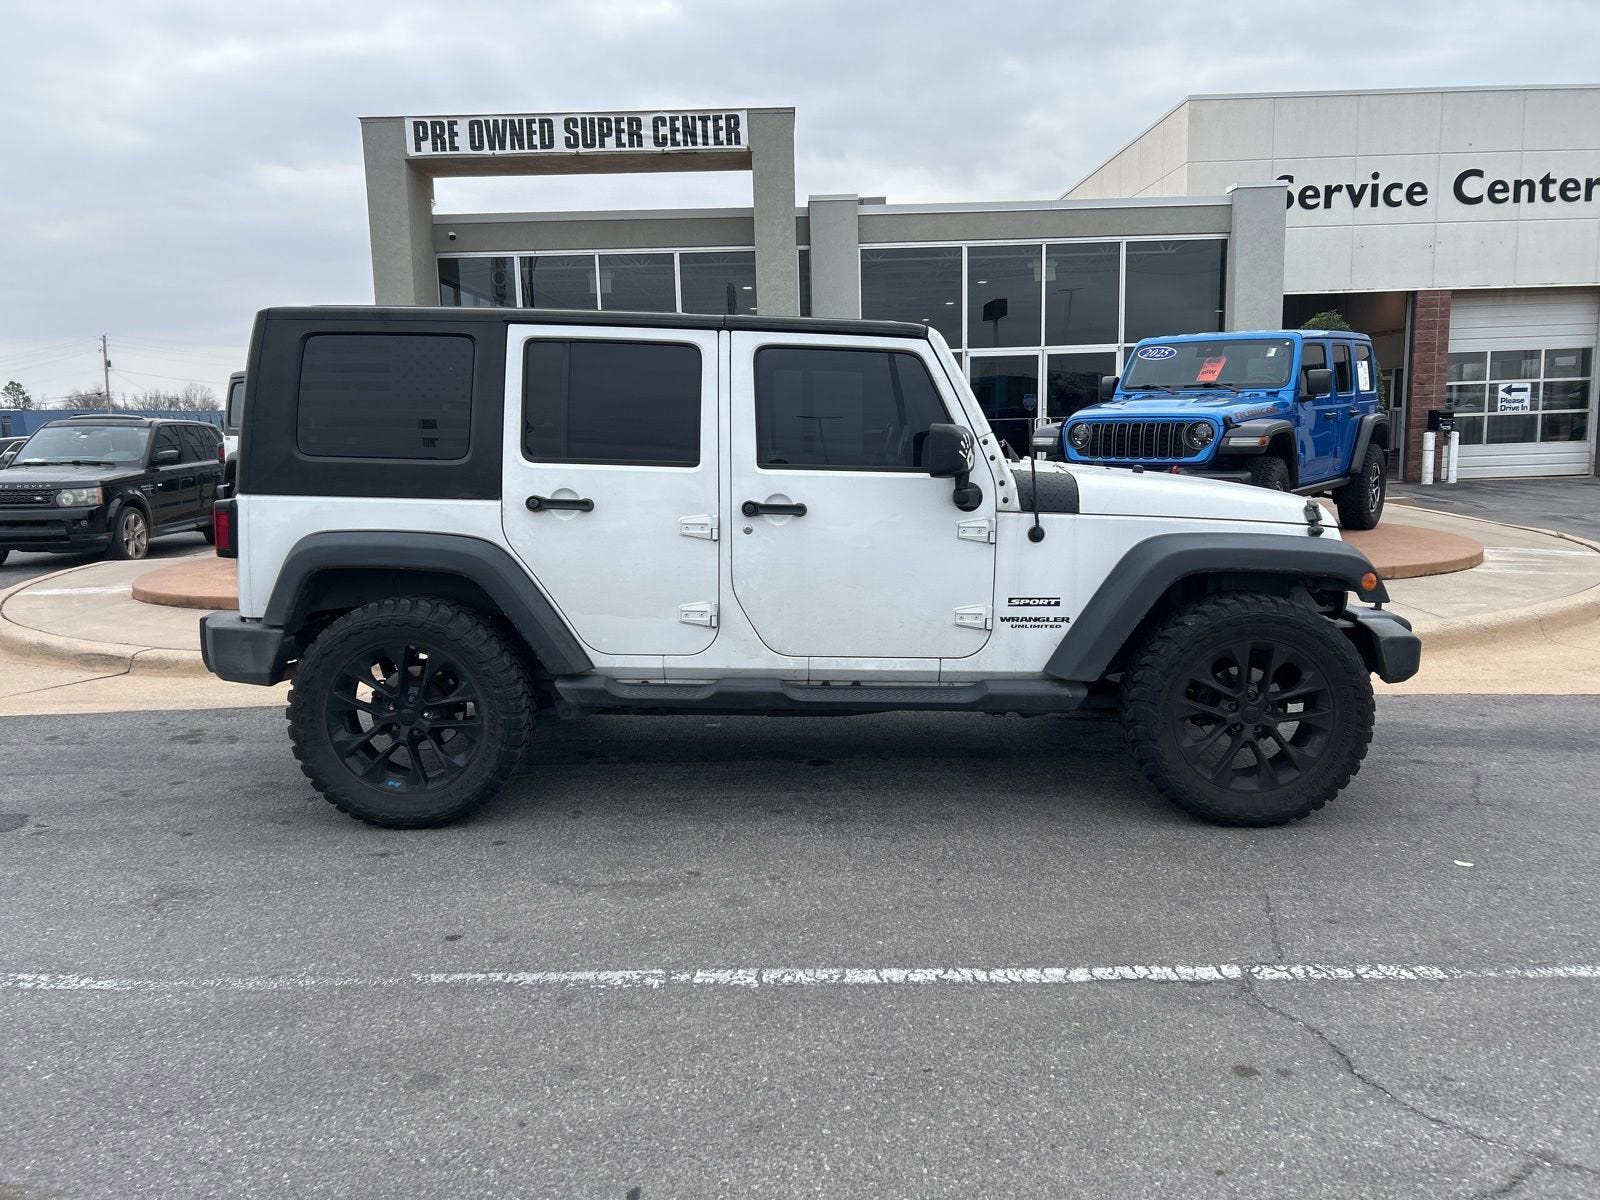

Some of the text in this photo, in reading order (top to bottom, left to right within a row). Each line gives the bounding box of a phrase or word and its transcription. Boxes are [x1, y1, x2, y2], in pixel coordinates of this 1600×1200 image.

[413, 113, 742, 153] PRE OWNED SUPER CENTER
[1453, 168, 1600, 205] Center
[1143, 348, 1171, 358] 2025
[1500, 404, 1520, 412] Drive
